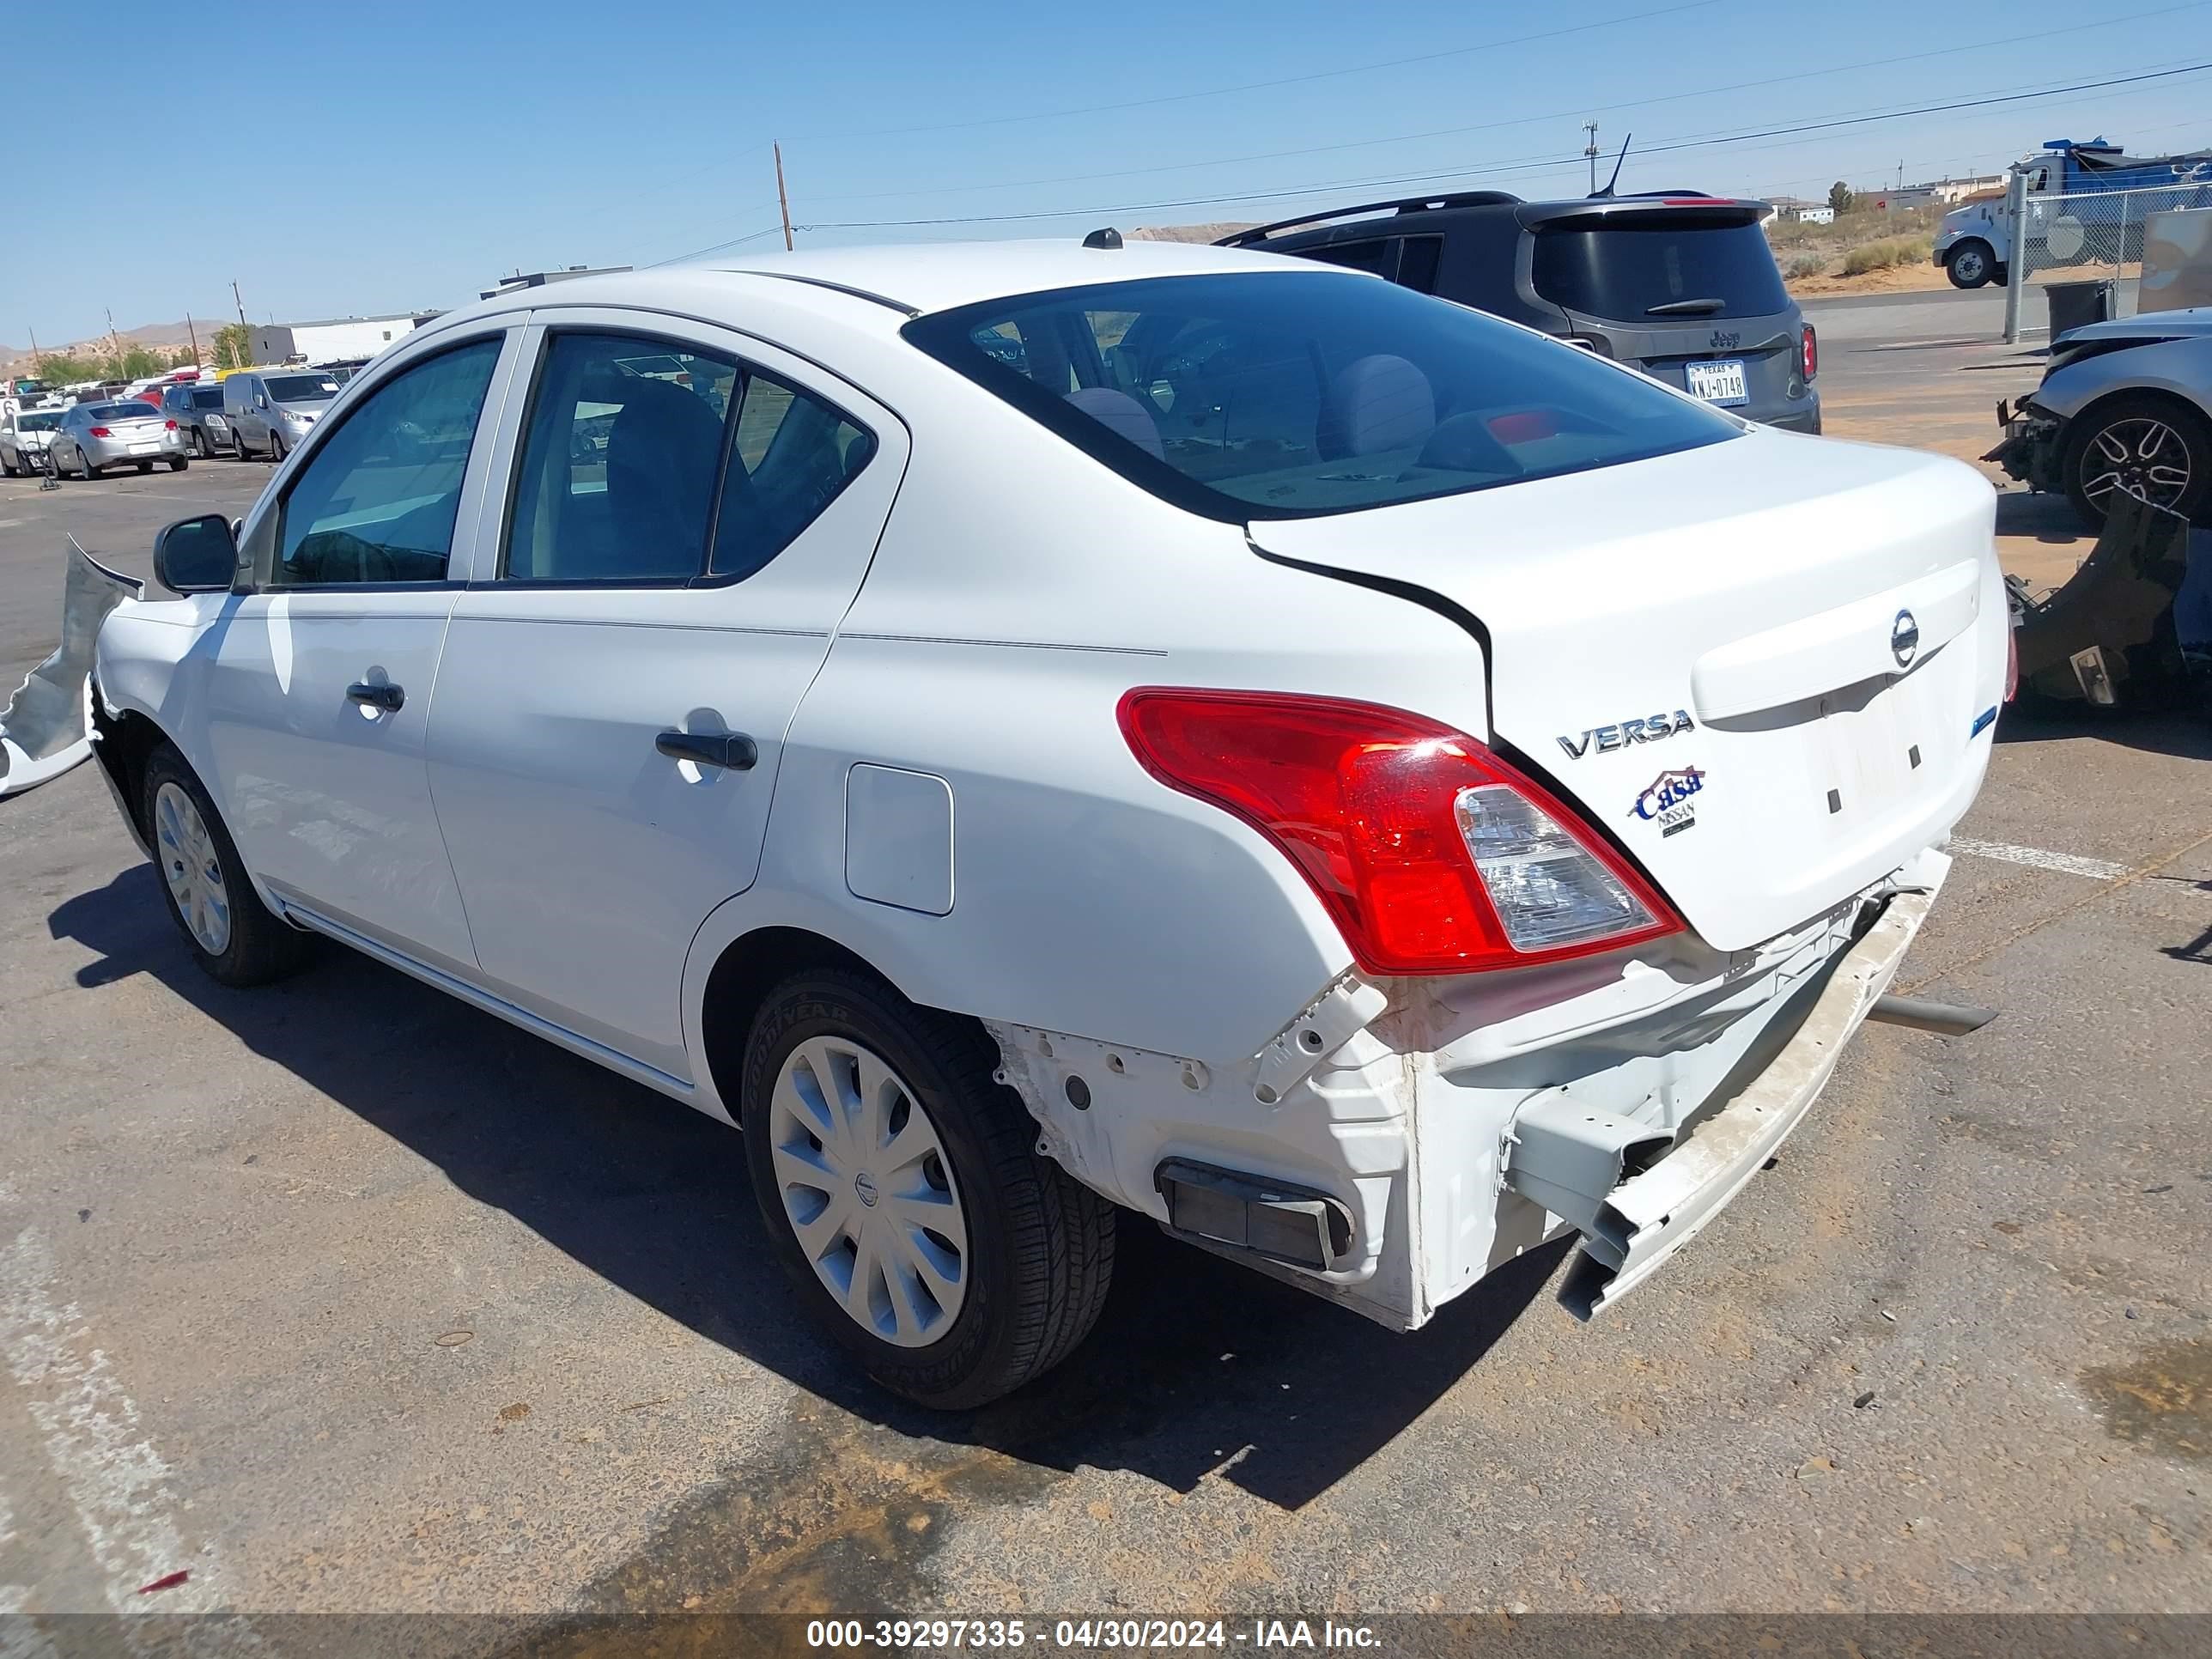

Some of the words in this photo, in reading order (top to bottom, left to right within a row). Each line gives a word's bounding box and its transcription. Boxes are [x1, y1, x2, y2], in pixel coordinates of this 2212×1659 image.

[1710, 330, 1740, 349] Jeep
[1704, 365, 1726, 374] TEXAS
[1556, 709, 1695, 760] VERSA
[1634, 772, 1705, 821] Casa
[1657, 801, 1695, 829] NISSAN
[748, 1001, 848, 1109] GOODYEAR
